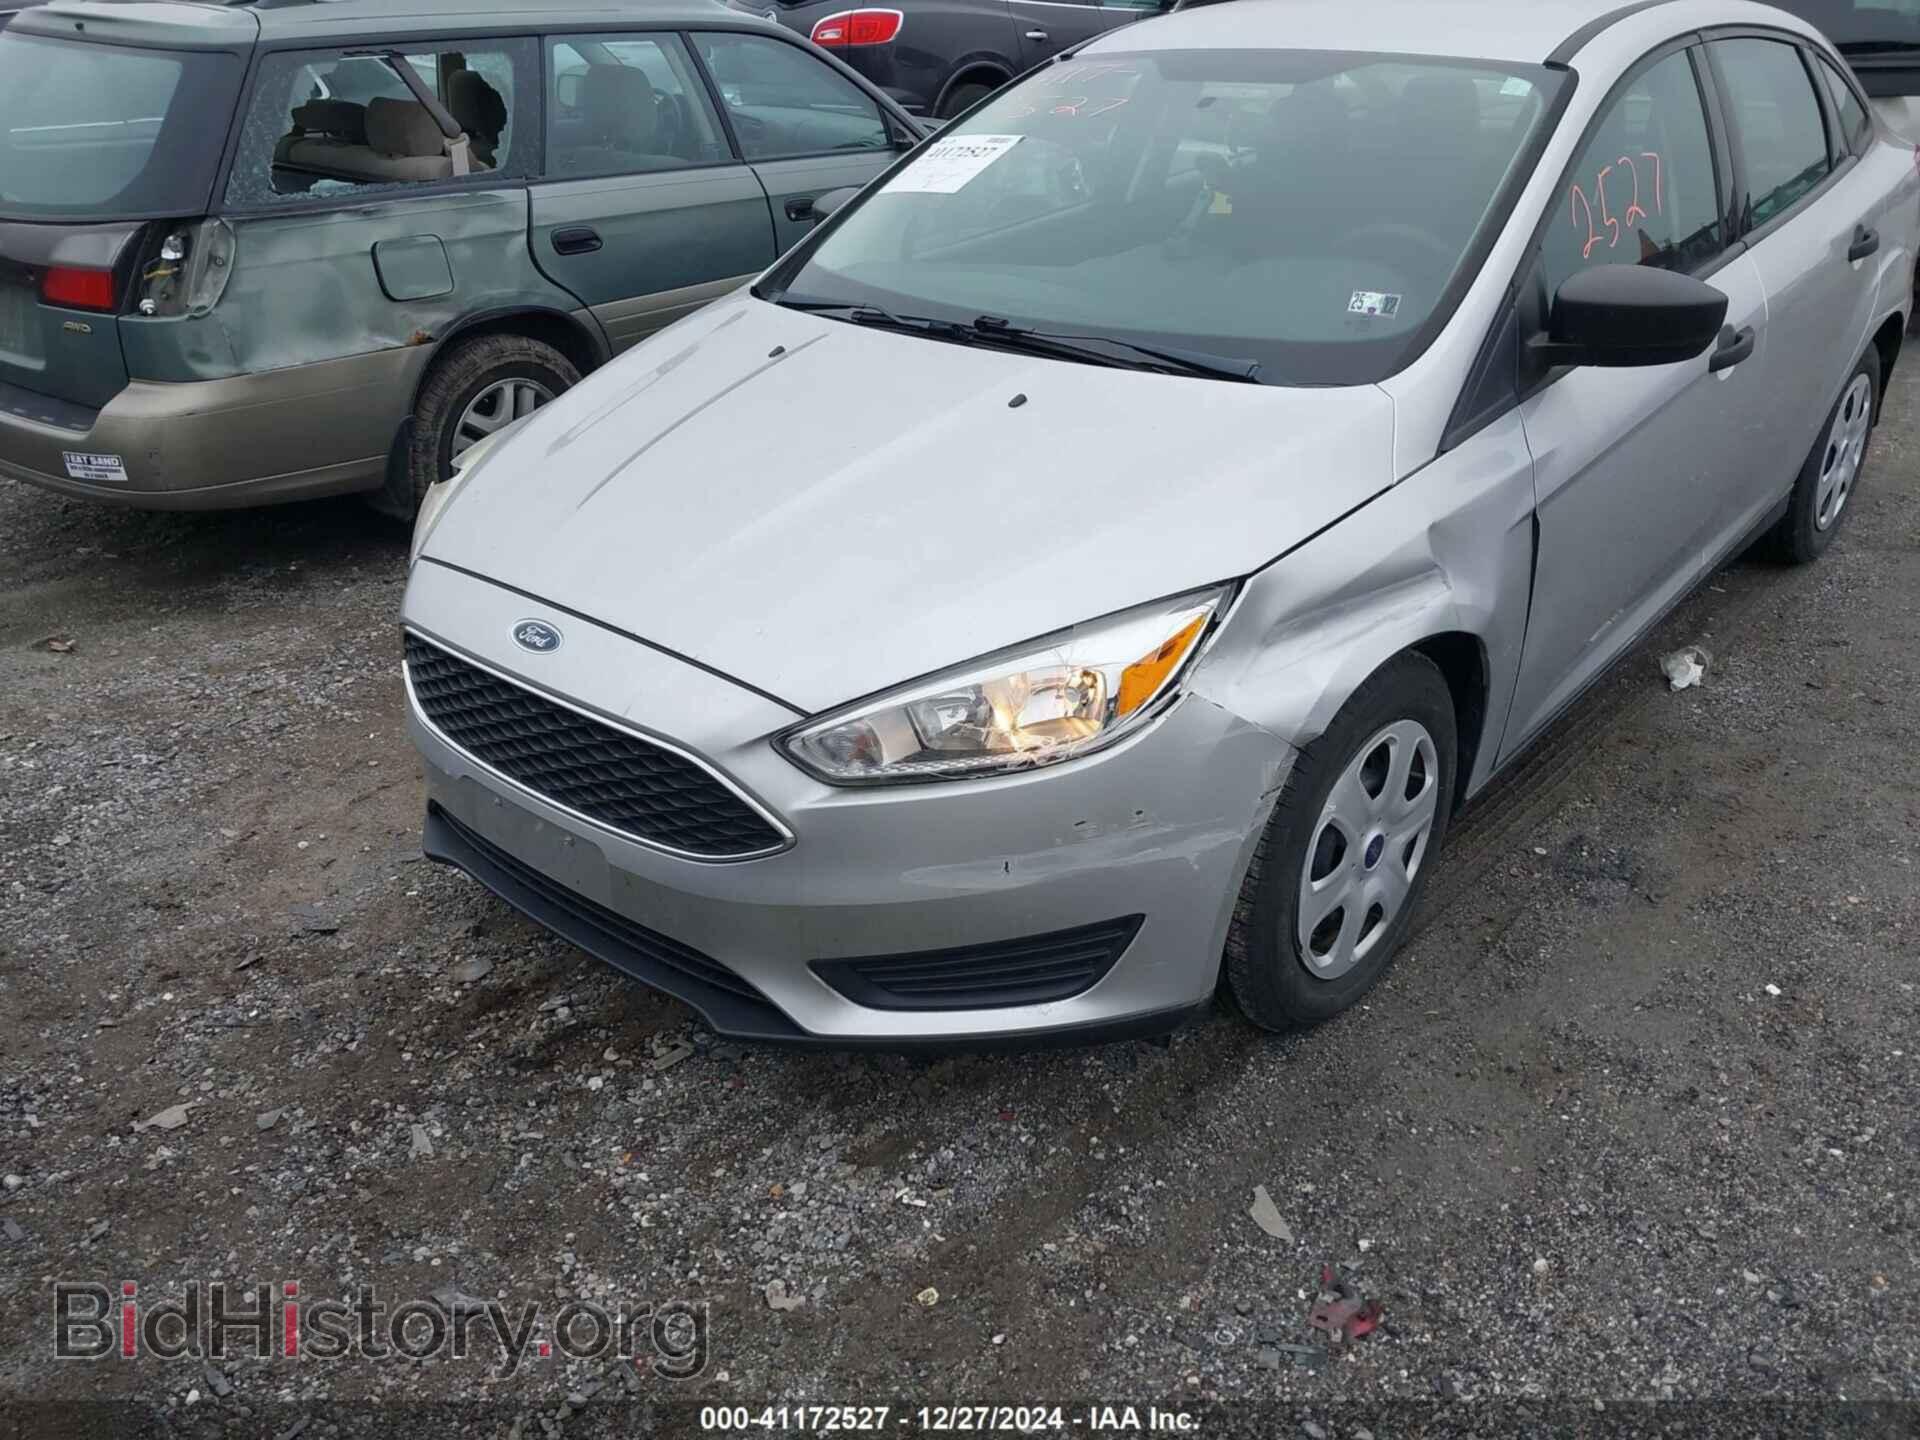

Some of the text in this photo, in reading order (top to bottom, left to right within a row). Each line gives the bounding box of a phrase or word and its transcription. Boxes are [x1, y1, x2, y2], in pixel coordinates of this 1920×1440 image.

[1570, 152, 1662, 258] 2527
[1350, 292, 1366, 310] 25
[519, 625, 552, 648] Ford
